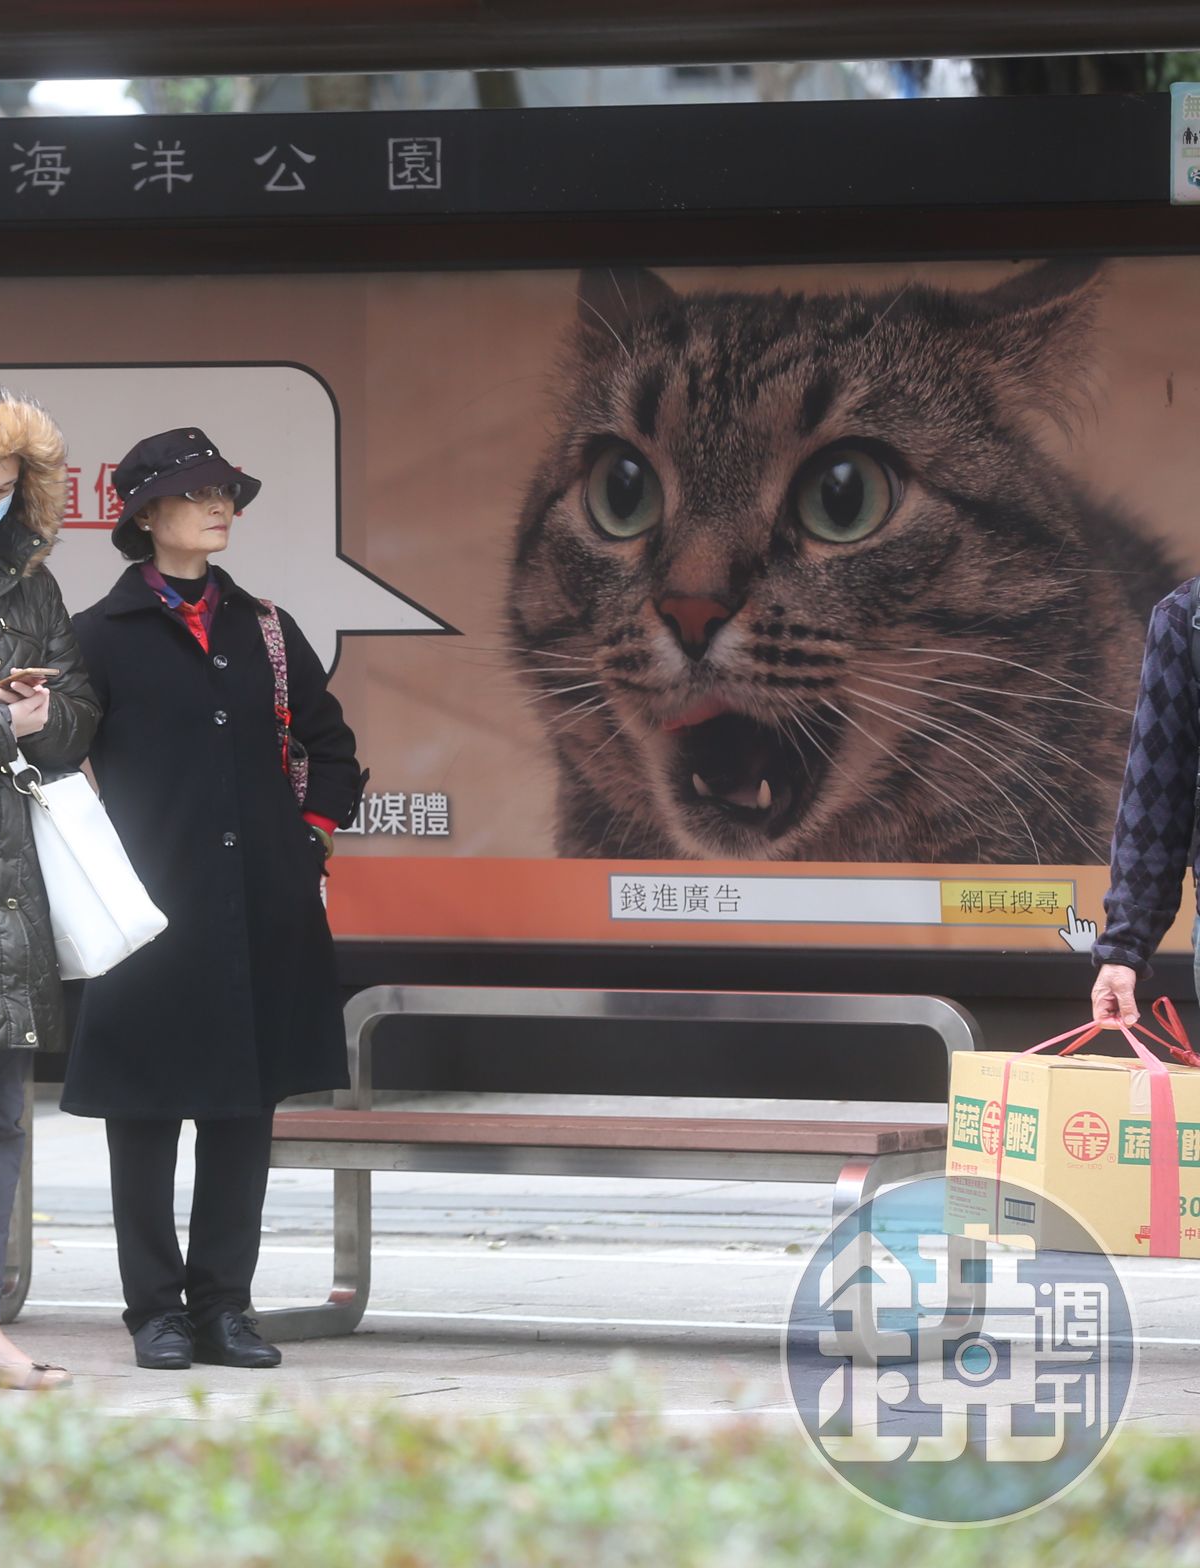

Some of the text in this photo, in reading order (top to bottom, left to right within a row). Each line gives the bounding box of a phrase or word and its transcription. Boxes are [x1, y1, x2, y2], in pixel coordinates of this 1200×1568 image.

[10, 138, 443, 196] 海洋公園
[619, 882, 742, 914] 錢進廣告
[959, 888, 1060, 915] 網頁搜尋
